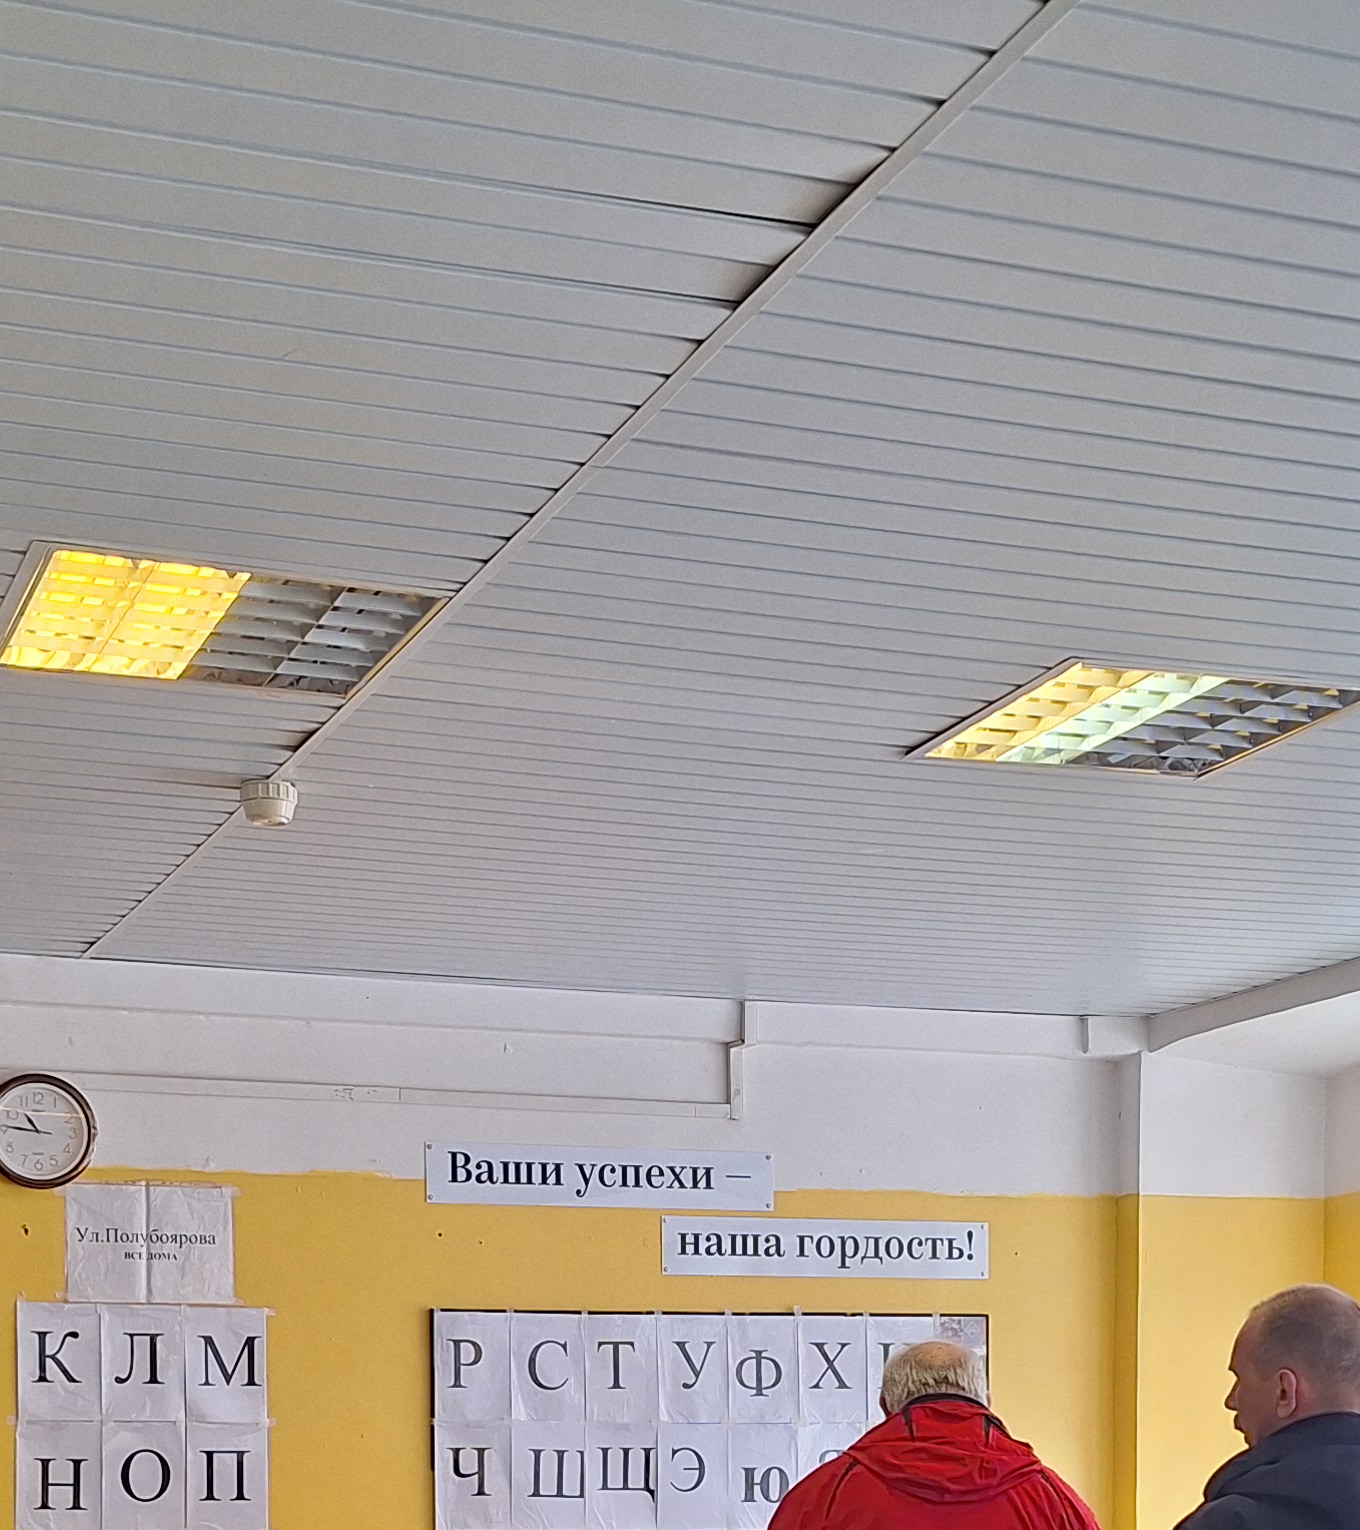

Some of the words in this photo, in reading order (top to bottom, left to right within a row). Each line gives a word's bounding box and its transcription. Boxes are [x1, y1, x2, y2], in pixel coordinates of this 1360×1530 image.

[32, 1091, 44, 1105] 12
[447, 1150, 565, 1186] Ваши
[574, 1161, 715, 1198] успехи
[75, 1226, 216, 1248] Ул.Полубоярова
[124, 1251, 143, 1261] ВСЕ
[147, 1252, 178, 1262] ДОМА
[677, 1231, 787, 1259] наша
[795, 1229, 975, 1270] гордость!
[30, 1330, 83, 1384] К
[114, 1332, 165, 1385] Л
[197, 1335, 263, 1387] М
[446, 1338, 483, 1389] Р
[527, 1340, 570, 1391] С
[597, 1341, 636, 1390] Т
[671, 1340, 717, 1390] У
[735, 1349, 783, 1398] Ф
[808, 1341, 853, 1390] Х
[33, 1457, 89, 1511] Н
[120, 1448, 171, 1503] О
[198, 1450, 252, 1502] П
[446, 1447, 492, 1497] Ч
[527, 1448, 585, 1499] Ш
[597, 1446, 656, 1504] Щ
[669, 1446, 706, 1493] Э
